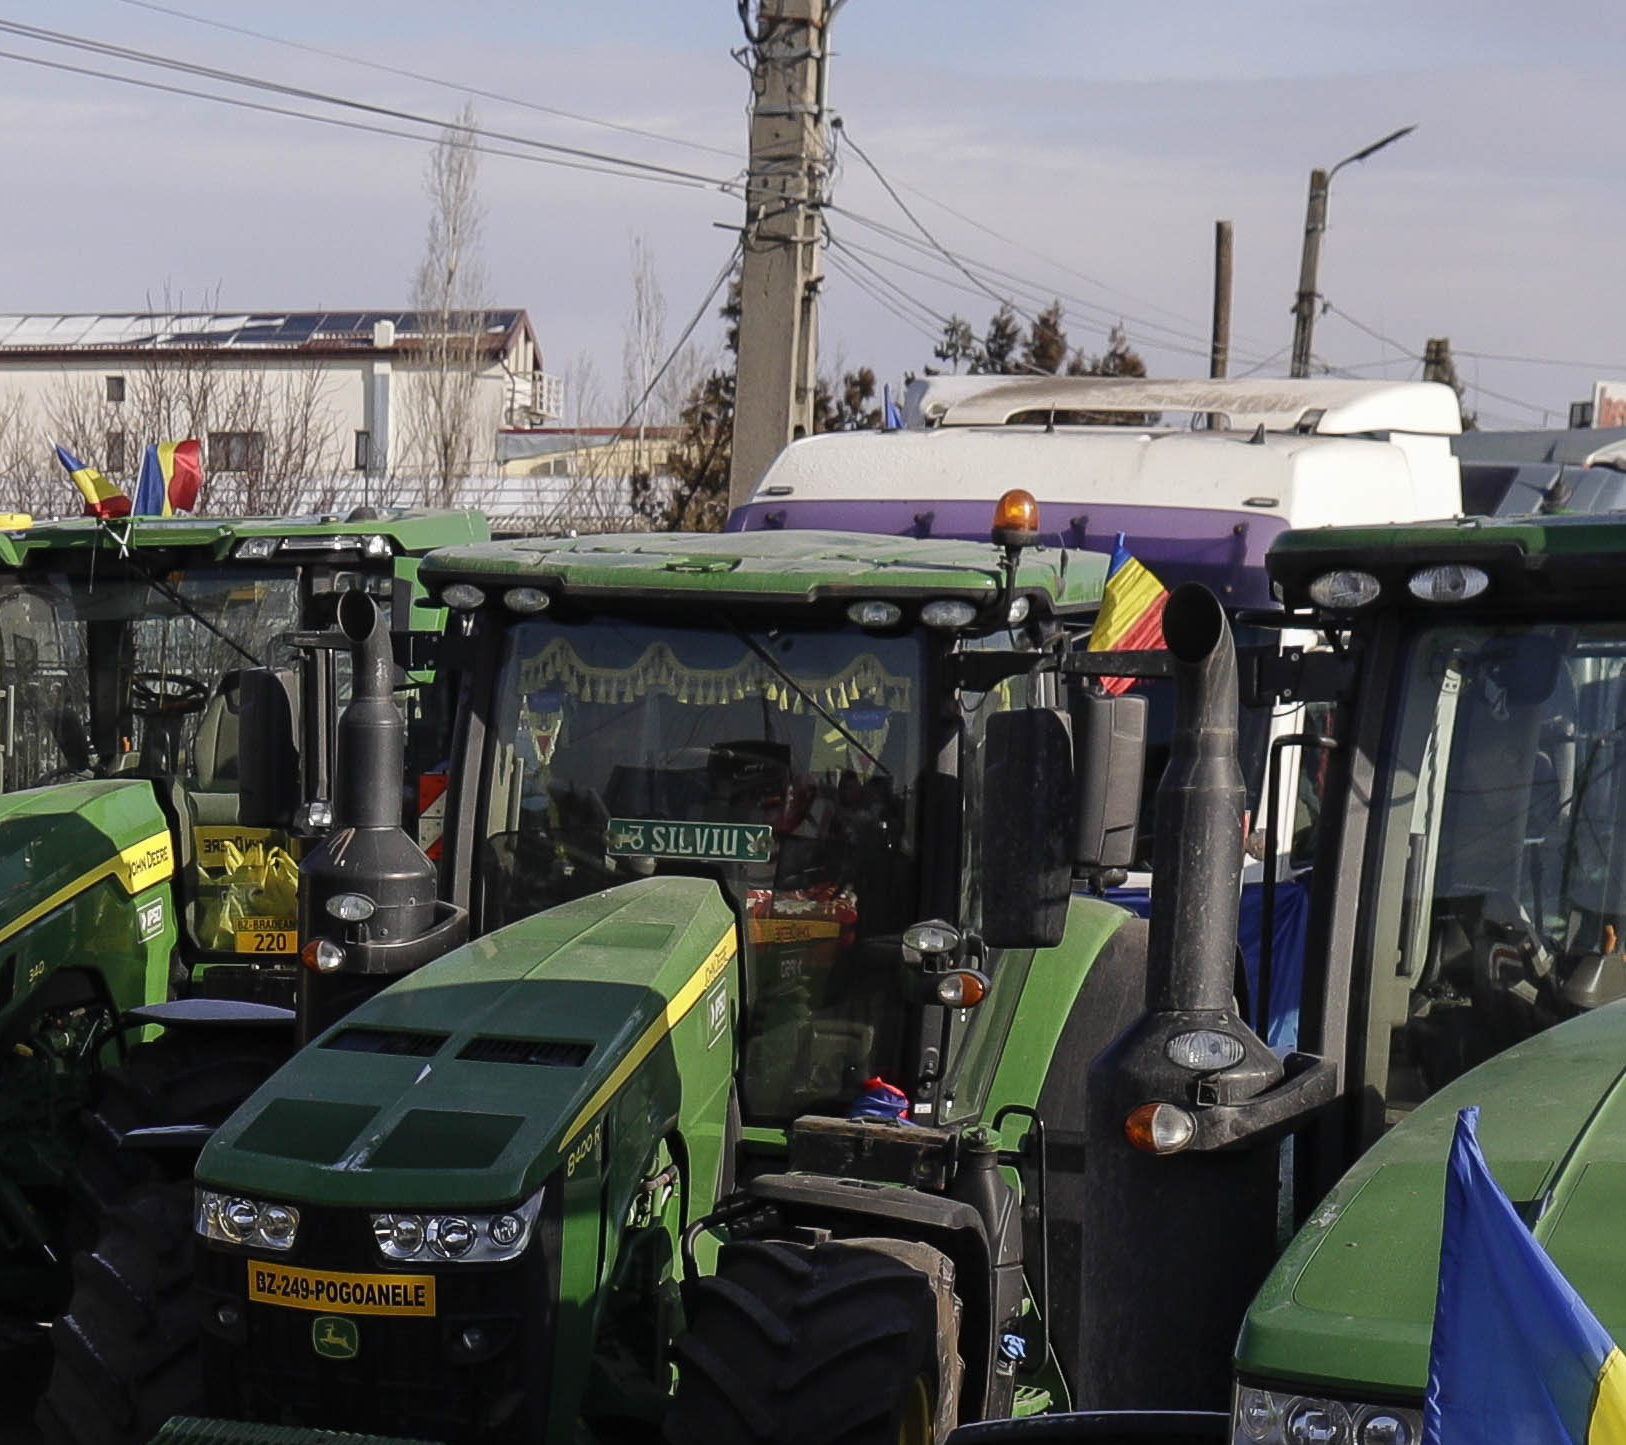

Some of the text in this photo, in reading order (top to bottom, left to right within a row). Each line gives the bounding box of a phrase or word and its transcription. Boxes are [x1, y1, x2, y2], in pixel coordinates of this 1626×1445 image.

[651, 826, 738, 857] SILVIU
[128, 846, 169, 878] JOHN DEERE
[254, 933, 287, 952] 220
[255, 1270, 426, 1308] BZ-249-POGOANELE
